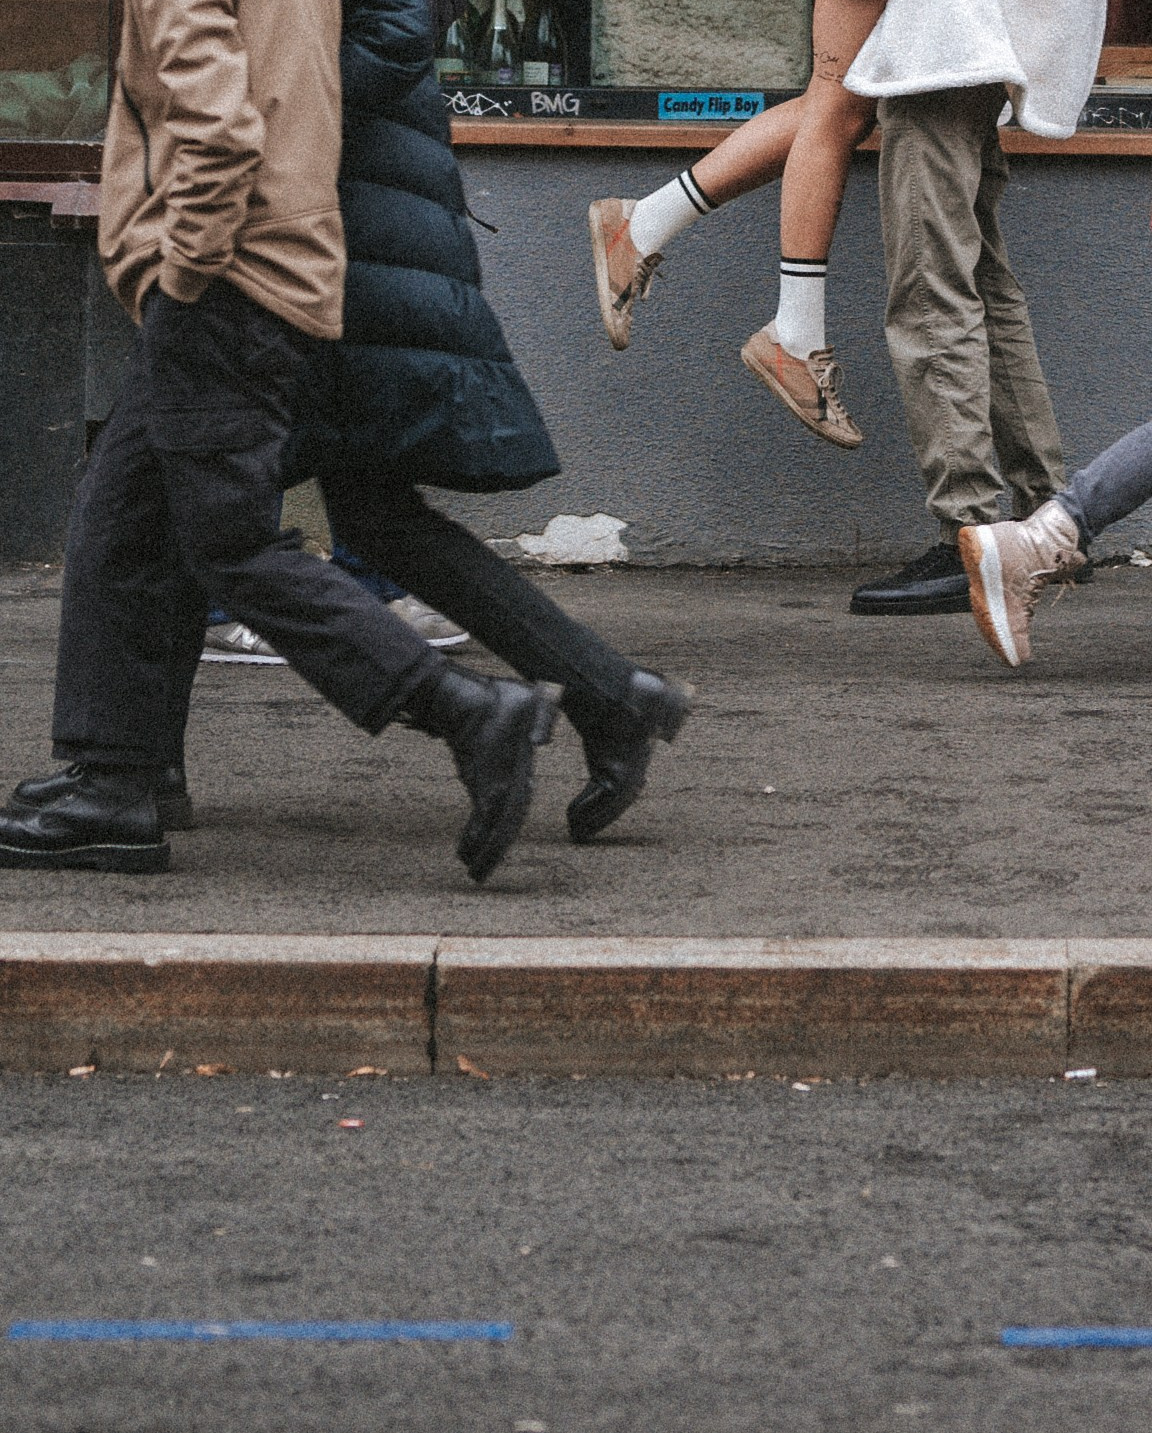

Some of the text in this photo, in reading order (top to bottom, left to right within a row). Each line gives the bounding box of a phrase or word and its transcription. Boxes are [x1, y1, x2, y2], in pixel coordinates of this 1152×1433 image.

[530, 91, 580, 116] BMG
[663, 97, 760, 116] Candy Flip Boy
